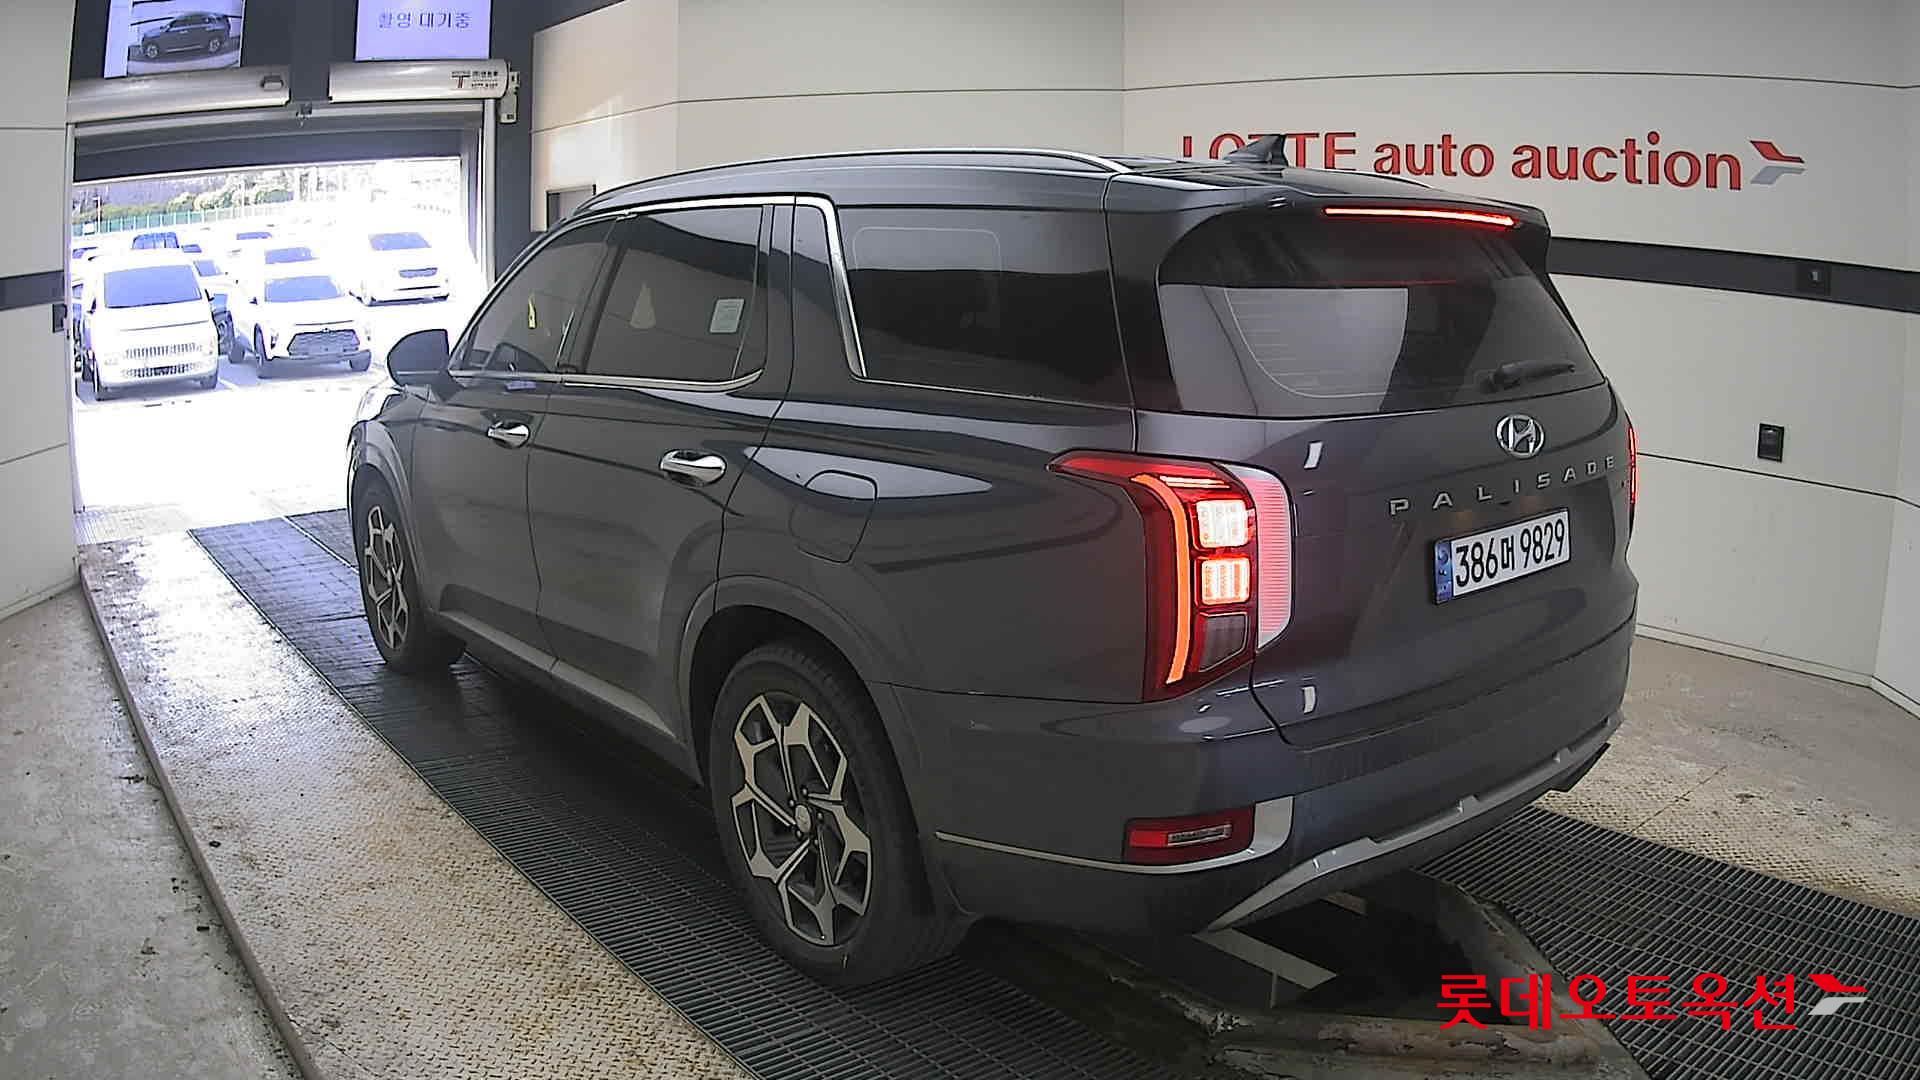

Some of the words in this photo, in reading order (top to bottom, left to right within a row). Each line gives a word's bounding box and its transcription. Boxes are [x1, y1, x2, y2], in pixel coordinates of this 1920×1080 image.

[419, 12, 470, 28] 대기중
[1183, 132, 1356, 171] OTE
[1374, 134, 1494, 177] auto
[1511, 131, 1742, 191] auction
[1389, 455, 1615, 516] PALISADE
[1455, 533, 1515, 587] 386머
[1520, 518, 1565, 569] 9829
